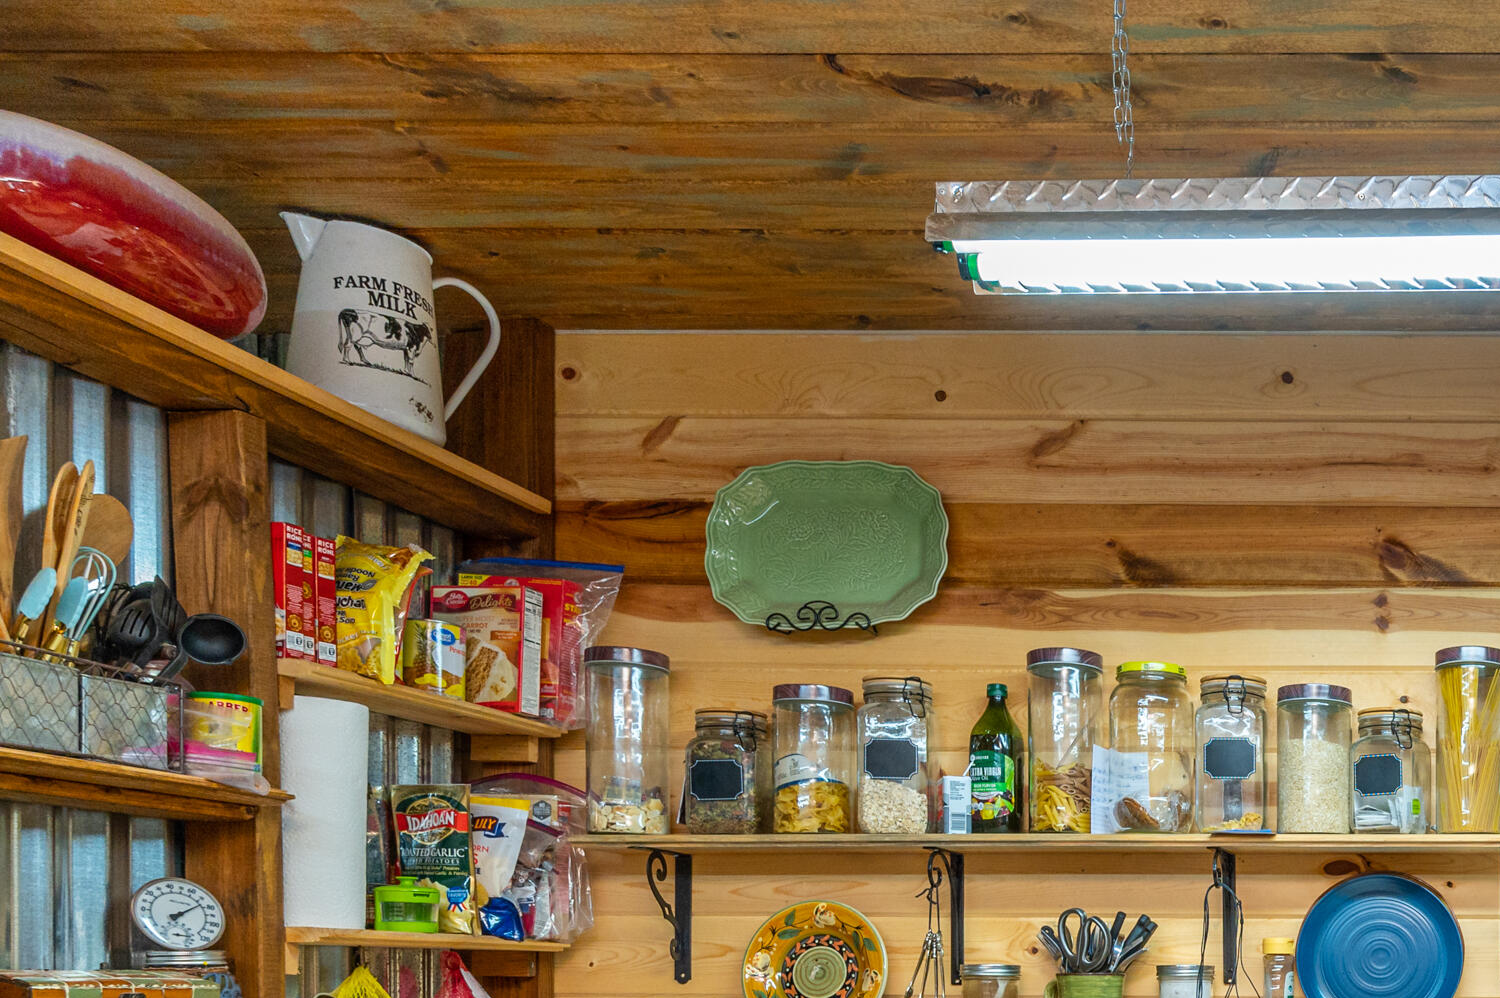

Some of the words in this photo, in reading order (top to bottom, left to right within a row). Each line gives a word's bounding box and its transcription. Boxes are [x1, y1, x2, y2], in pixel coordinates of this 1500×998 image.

[333, 275, 388, 293] FARM
[391, 281, 434, 318] FRESH
[367, 290, 418, 320] MILK
[286, 525, 303, 536] RICE
[317, 539, 334, 549] RICE
[469, 593, 513, 610] Delights
[405, 810, 456, 831] IDAHOAN
[474, 818, 497, 830] LILY
[430, 847, 465, 858] GARLIC
